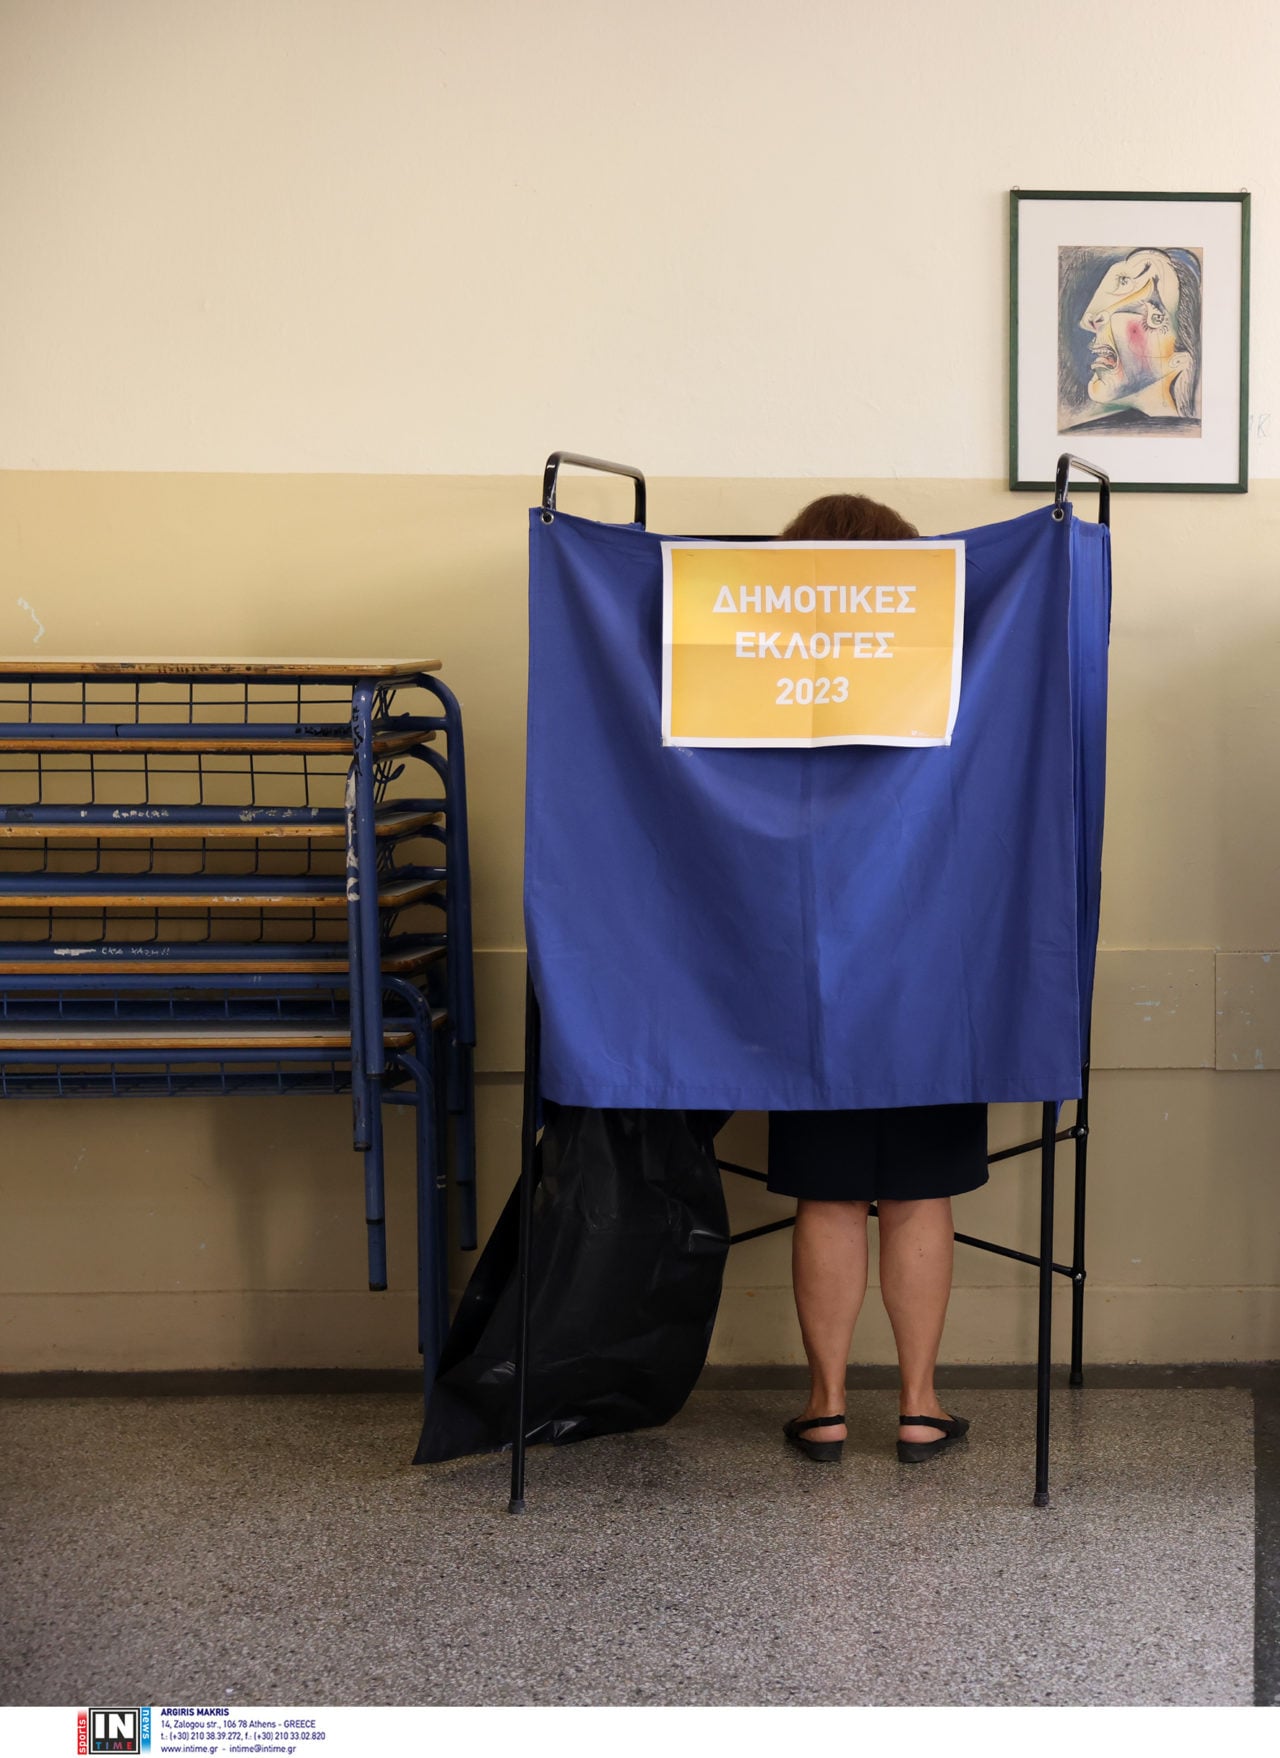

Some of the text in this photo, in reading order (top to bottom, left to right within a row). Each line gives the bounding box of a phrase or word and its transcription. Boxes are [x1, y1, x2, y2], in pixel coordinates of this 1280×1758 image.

[712, 585, 917, 614] ΔΗΜΟΤΙΚΕΣ
[735, 631, 895, 659] ΕΚΛΟΓΕΣ
[775, 676, 849, 705] 2023
